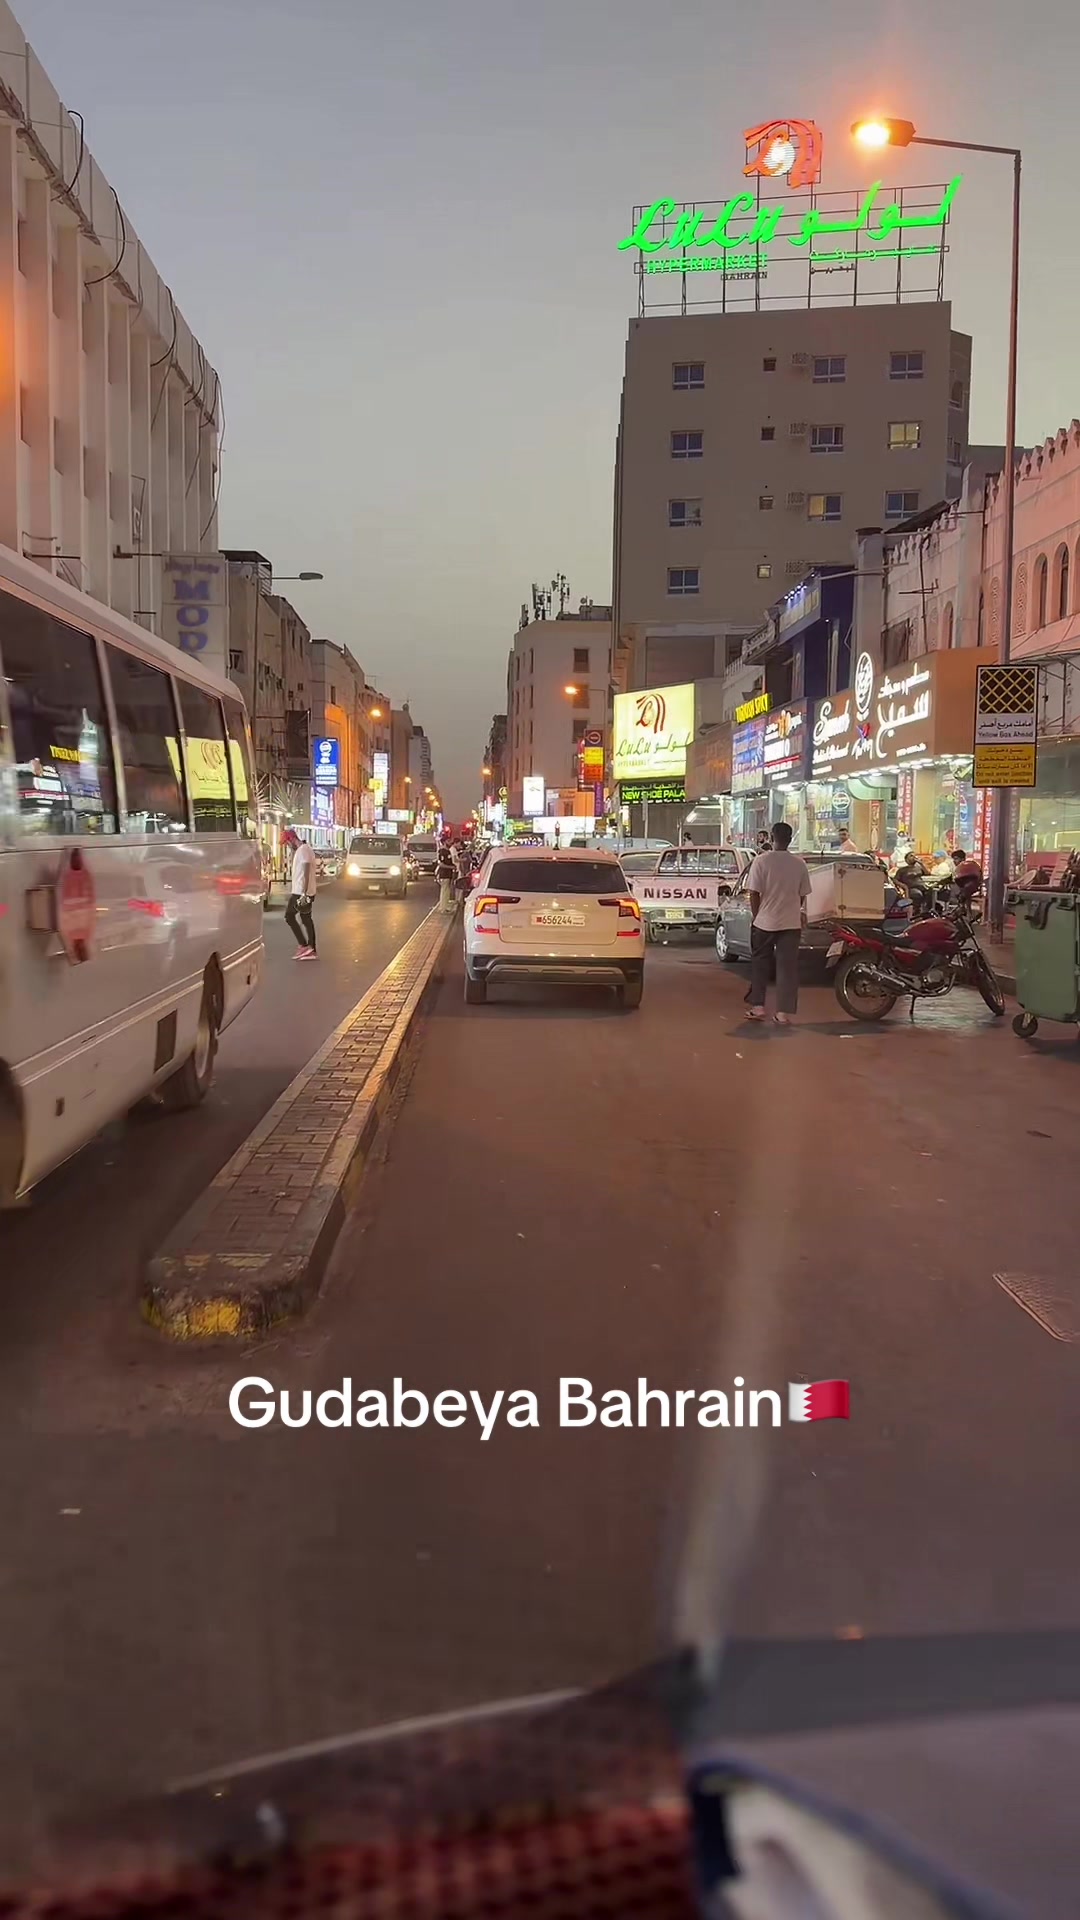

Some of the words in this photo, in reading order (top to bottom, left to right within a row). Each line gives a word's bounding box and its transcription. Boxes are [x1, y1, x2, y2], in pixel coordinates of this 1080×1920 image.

[787, 172, 965, 247] لولو
[646, 253, 769, 275] HYPERMARKET
[978, 718, 997, 731] أصفر
[997, 722, 1012, 731] مربع
[1013, 717, 1033, 728] أمامك
[978, 731, 998, 739] Yellow
[999, 731, 1012, 739] Box
[1013, 731, 1033, 739] Ahead
[622, 792, 640, 800] NEW
[641, 791, 663, 800] SHOE
[643, 887, 707, 900] NISSAN
[542, 915, 573, 925] 656244
